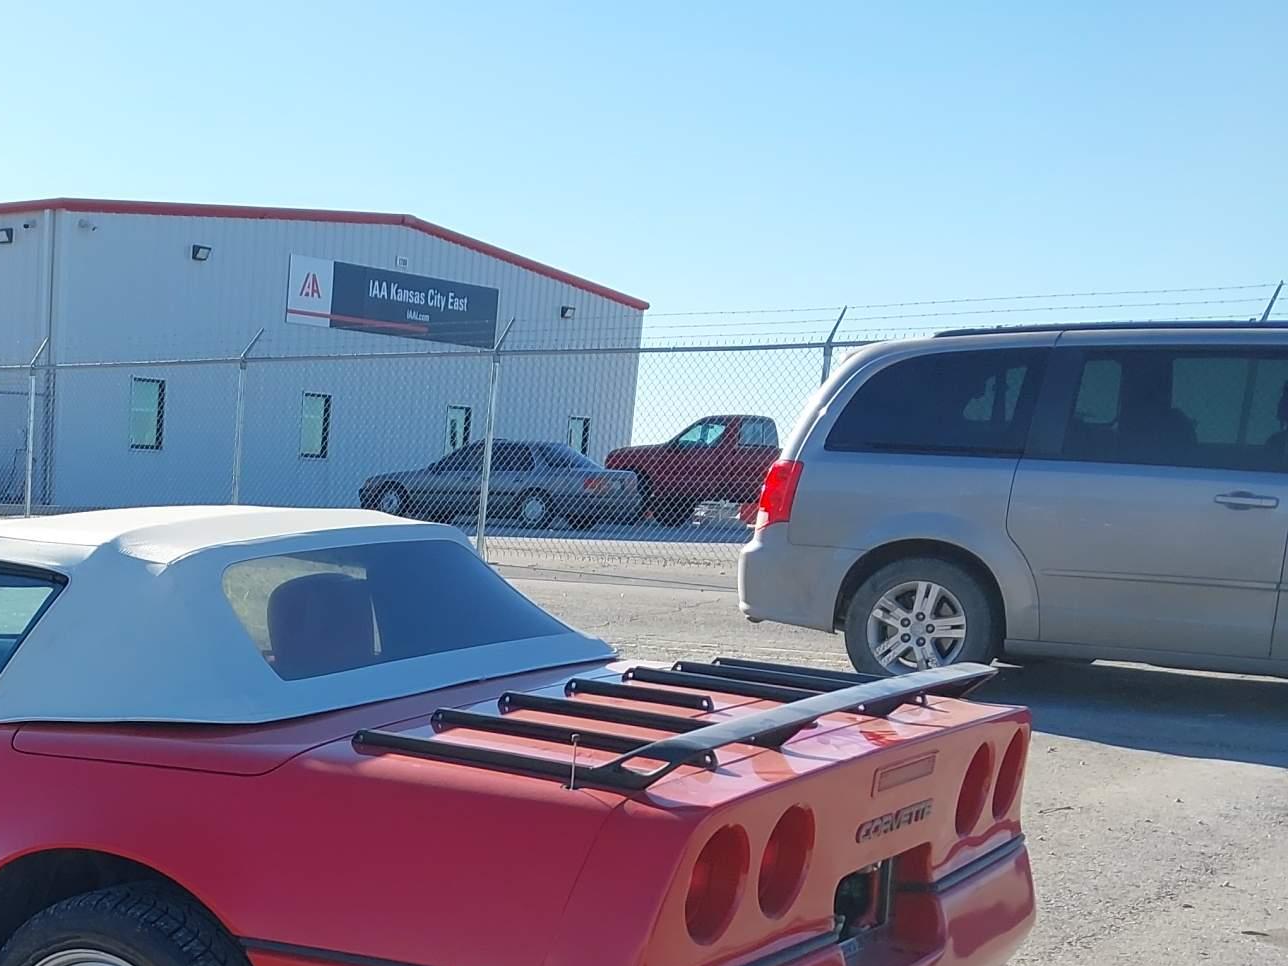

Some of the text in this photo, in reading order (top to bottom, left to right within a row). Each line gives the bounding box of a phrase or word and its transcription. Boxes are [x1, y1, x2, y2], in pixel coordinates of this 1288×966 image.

[368, 279, 468, 312] IAA Kansas City East
[855, 798, 933, 844] CORVETTE
